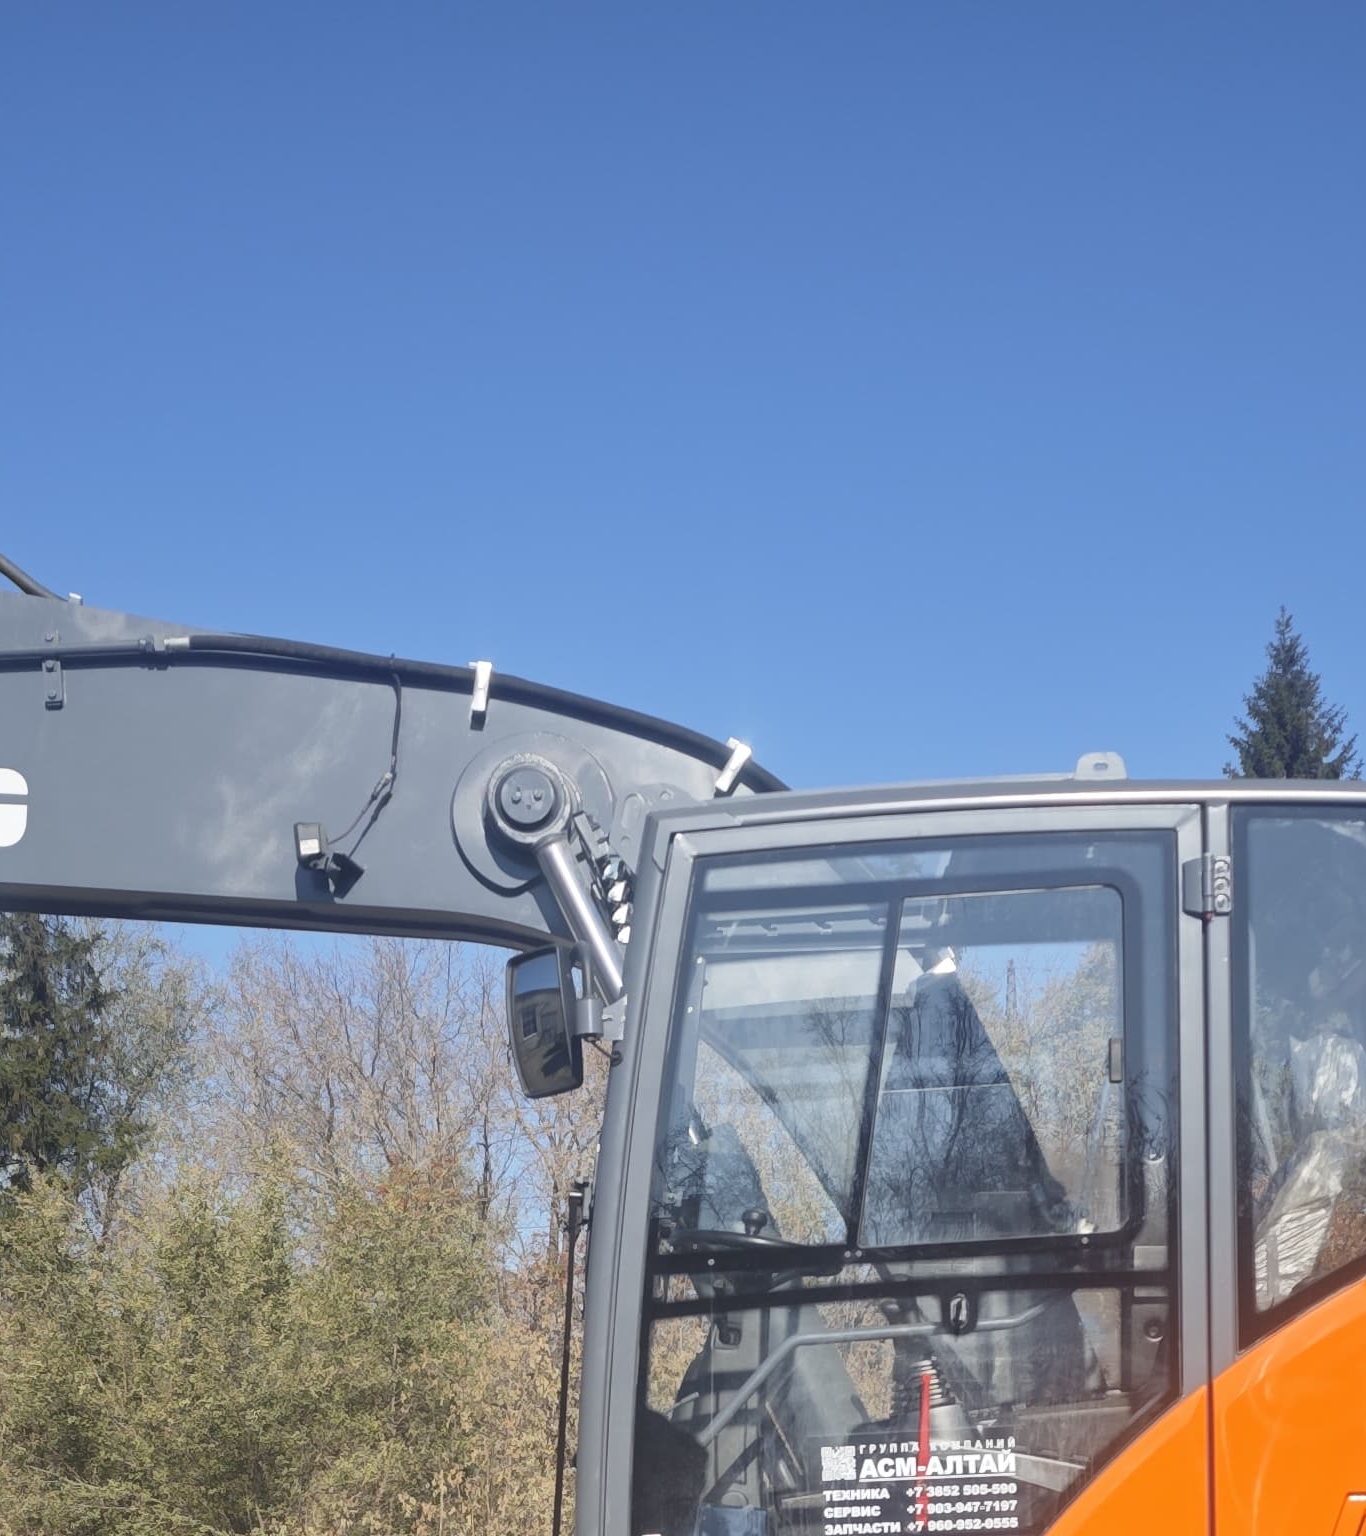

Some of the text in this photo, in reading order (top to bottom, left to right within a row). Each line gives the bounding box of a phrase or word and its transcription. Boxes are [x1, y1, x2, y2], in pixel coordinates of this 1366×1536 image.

[859, 1440, 920, 1455] ГРУППА
[859, 1449, 1016, 1479] АСМ-АЛТАЙ
[823, 1487, 891, 1502] ТЕХНИКА
[905, 1485, 924, 1498] +7
[824, 1505, 881, 1519] СЕРВИС
[906, 1503, 924, 1516] +7
[825, 1521, 902, 1536] ЗАПЧАСТИ
[907, 1519, 925, 1533] +7
